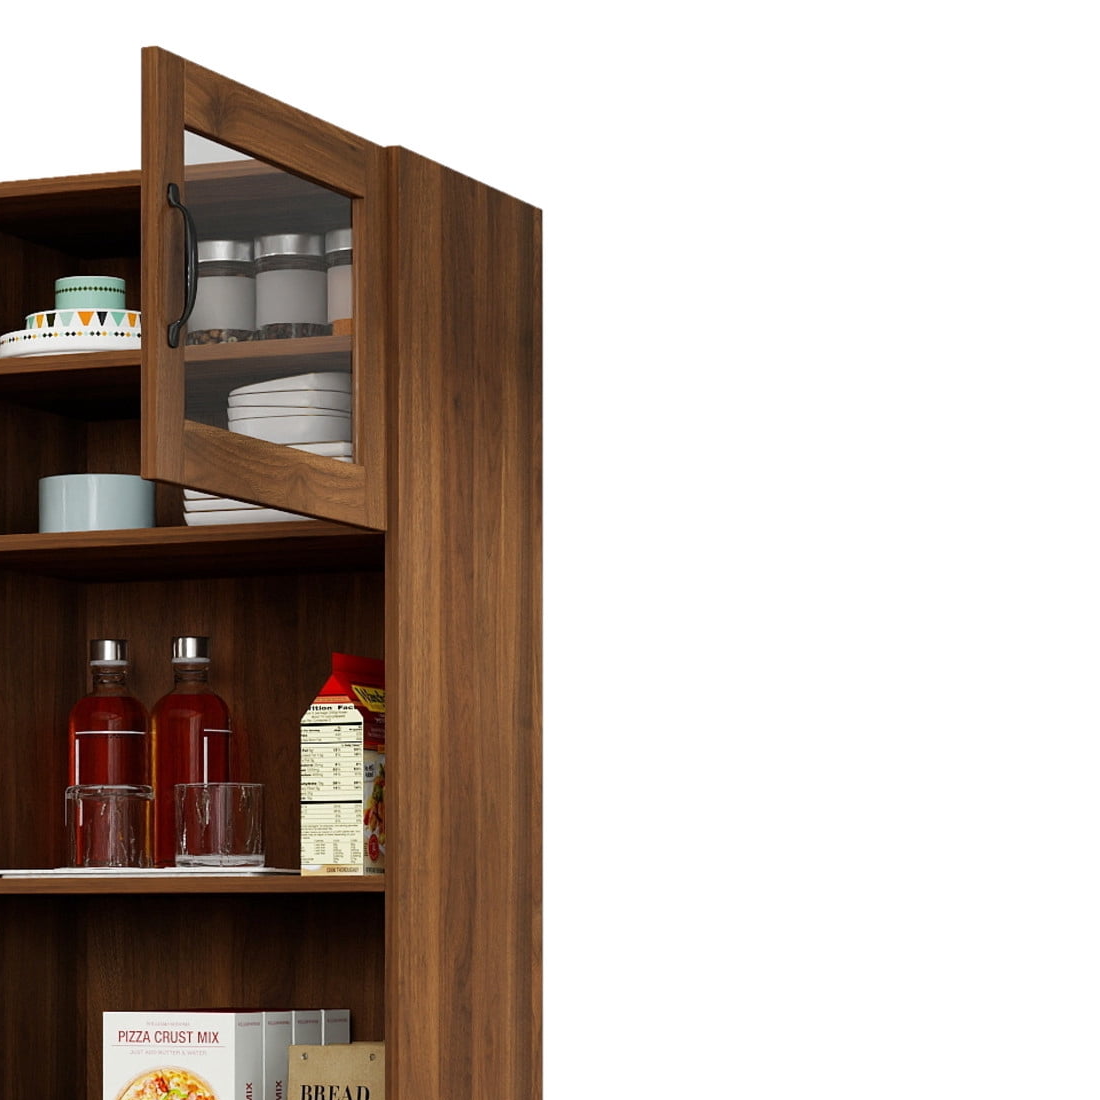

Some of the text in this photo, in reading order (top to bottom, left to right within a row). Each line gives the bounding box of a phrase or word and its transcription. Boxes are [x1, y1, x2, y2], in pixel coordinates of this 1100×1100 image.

[118, 1030, 220, 1044] PIZZA CRUST MIX
